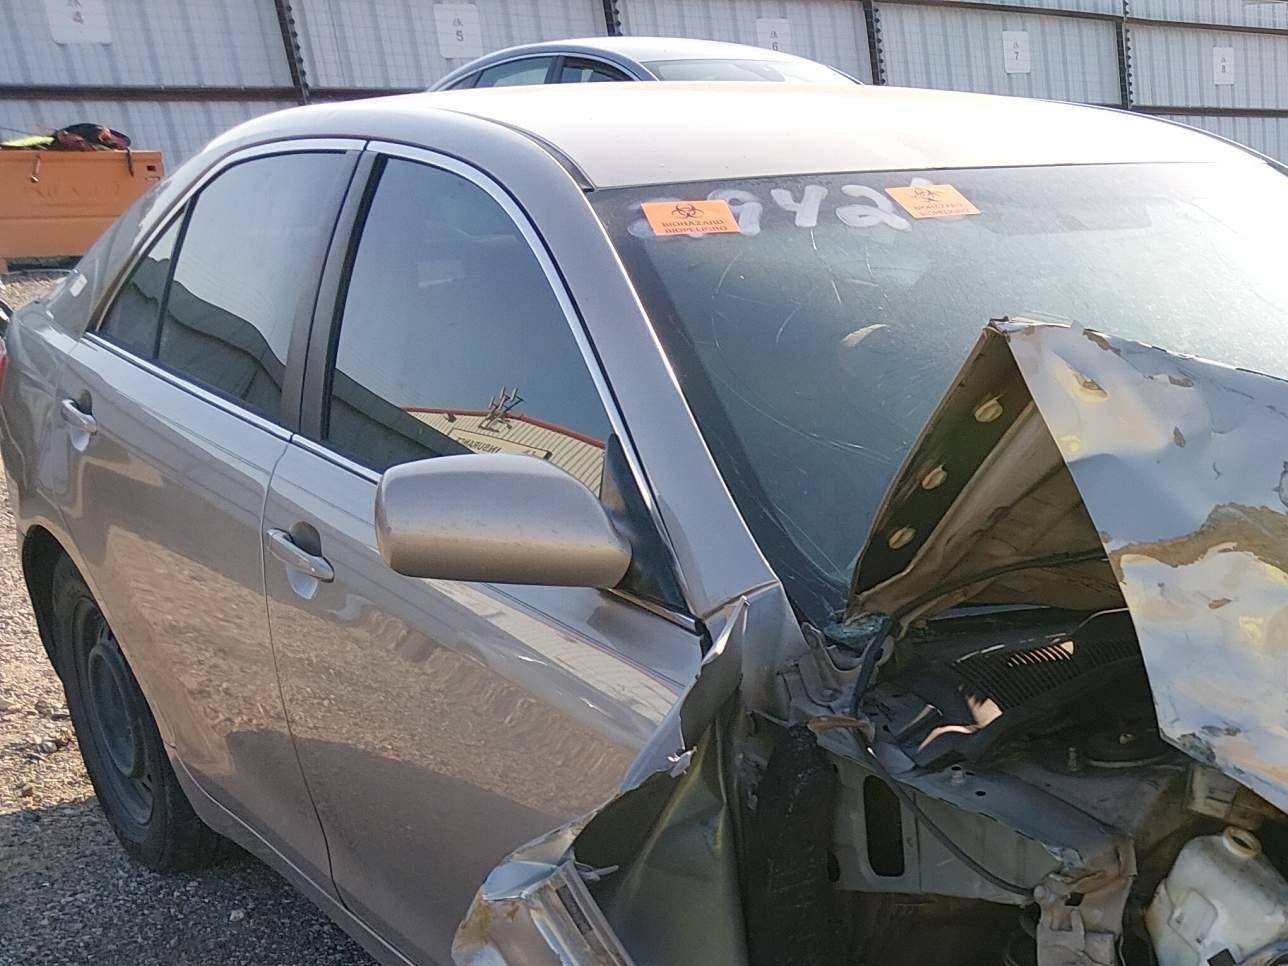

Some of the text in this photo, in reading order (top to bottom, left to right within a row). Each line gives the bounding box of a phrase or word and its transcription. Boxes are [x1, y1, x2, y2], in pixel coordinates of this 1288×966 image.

[456, 30, 464, 41] 5
[772, 41, 778, 51] 6
[661, 219, 725, 228] BIOHAZARD
